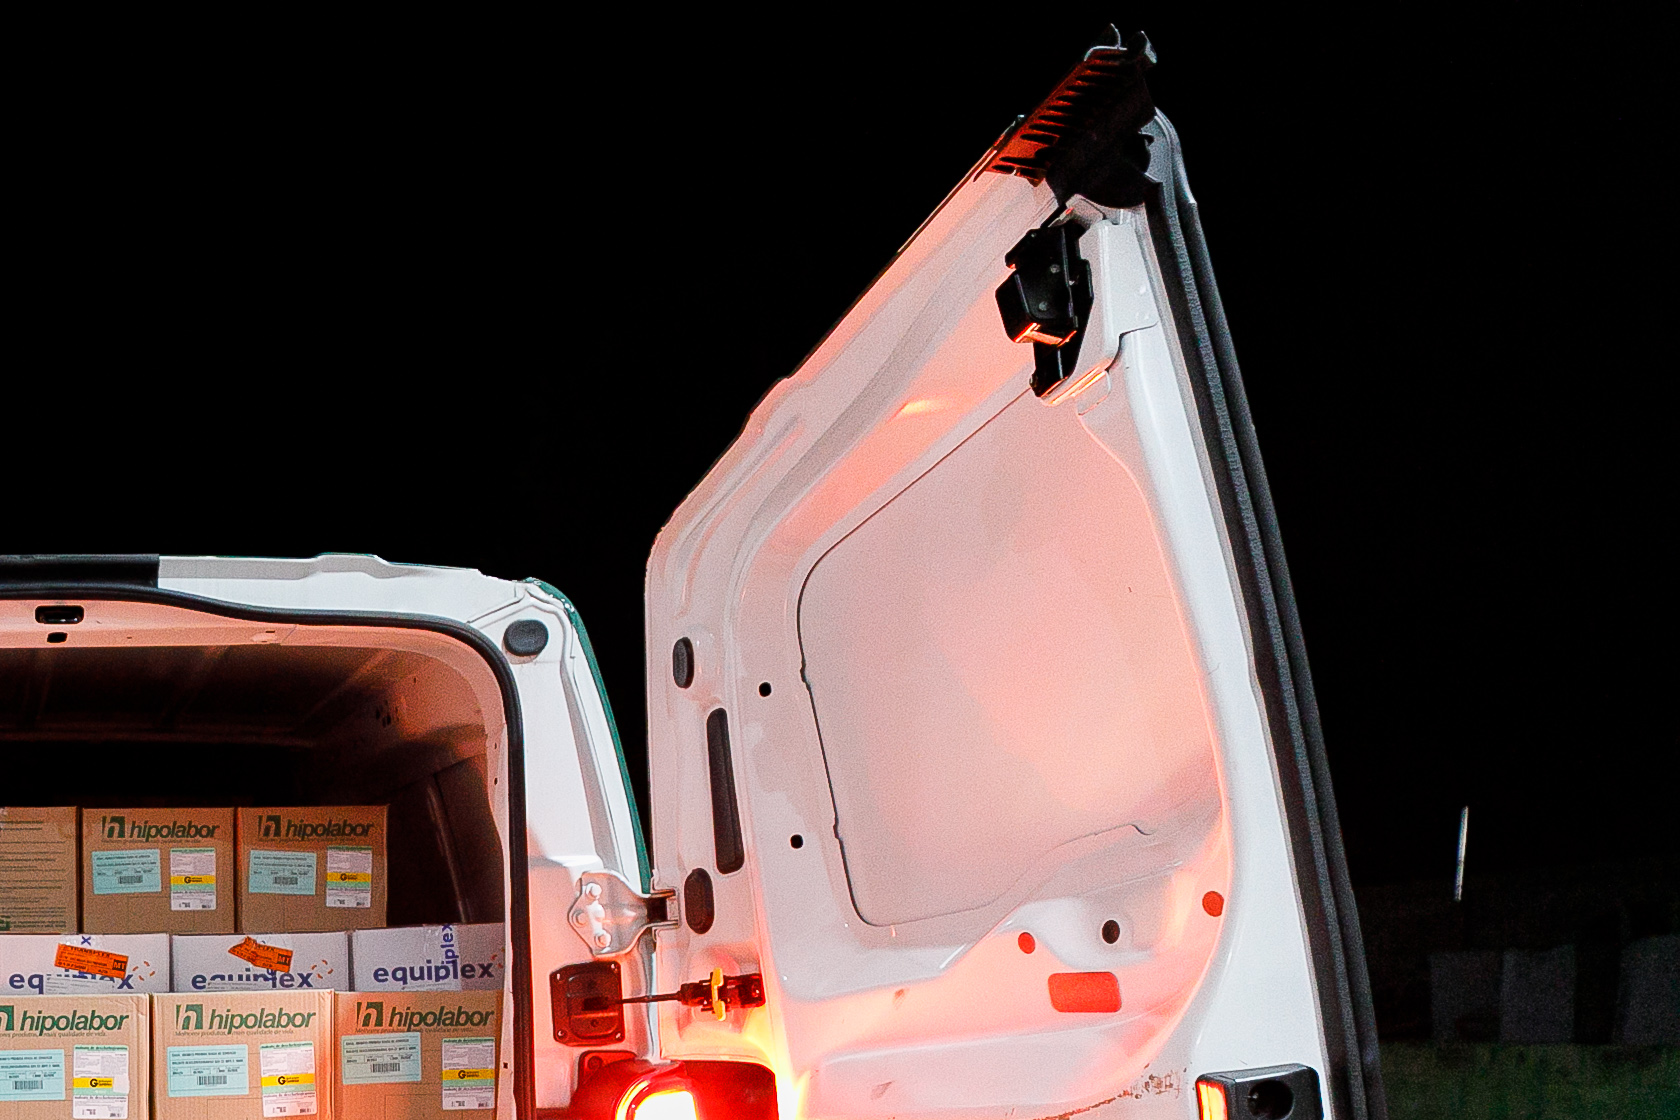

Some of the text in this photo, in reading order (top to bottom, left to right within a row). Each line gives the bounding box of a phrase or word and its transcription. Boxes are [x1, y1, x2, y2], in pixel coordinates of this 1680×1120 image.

[130, 820, 220, 843] hipolabor
[285, 819, 374, 841] hipolabor
[373, 959, 495, 985] equiplex
[20, 1010, 129, 1036] hipolabor
[209, 1008, 316, 1035] hipolabor
[388, 1006, 495, 1032] hipolabor
